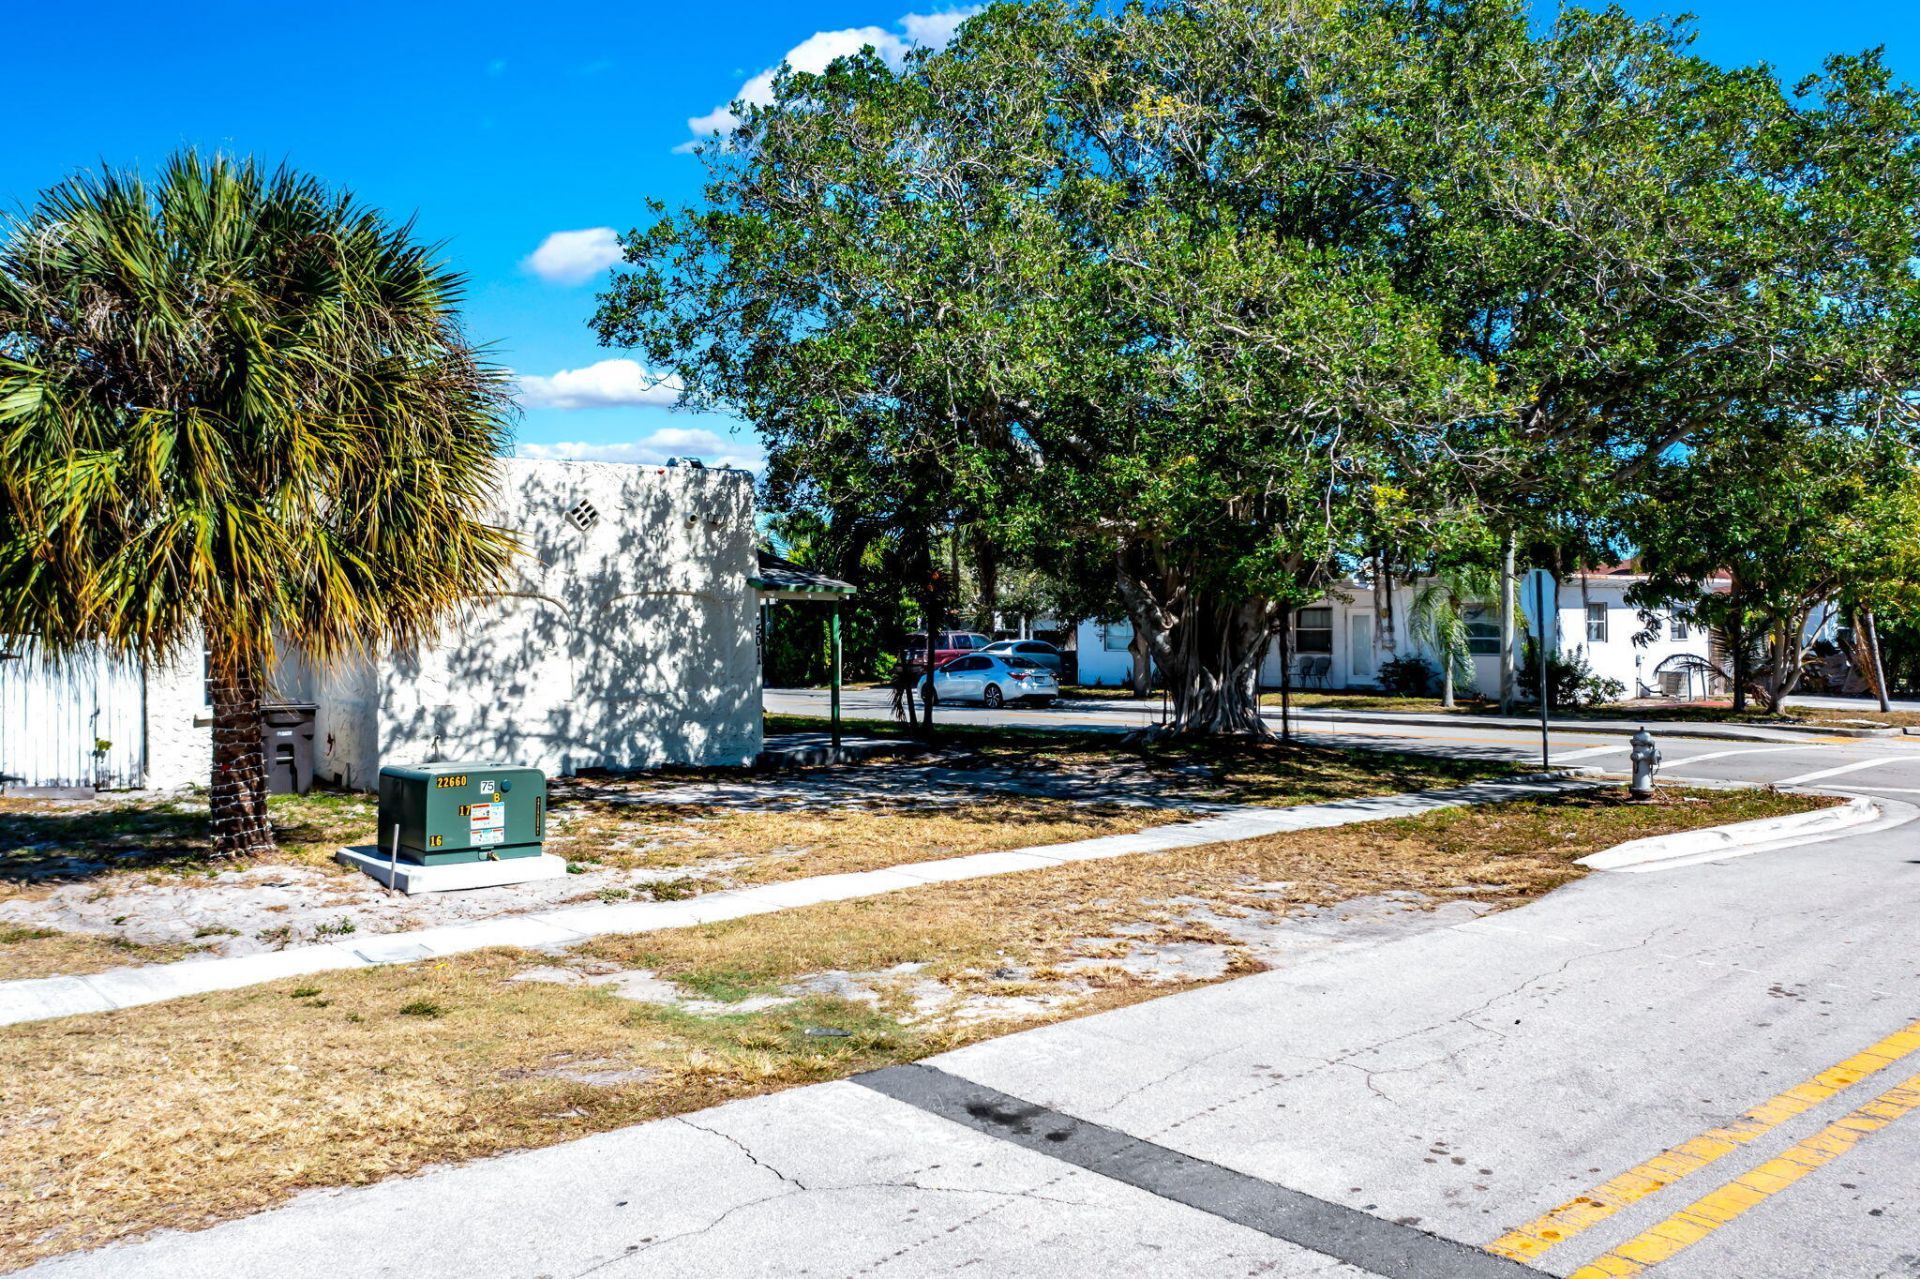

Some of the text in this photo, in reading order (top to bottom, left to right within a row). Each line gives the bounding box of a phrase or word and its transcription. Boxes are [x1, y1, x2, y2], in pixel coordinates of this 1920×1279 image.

[437, 776, 467, 788] 22660
[482, 781, 494, 791] 75
[494, 793, 501, 802] B
[459, 805, 471, 816] 17
[430, 836, 442, 847] 16
